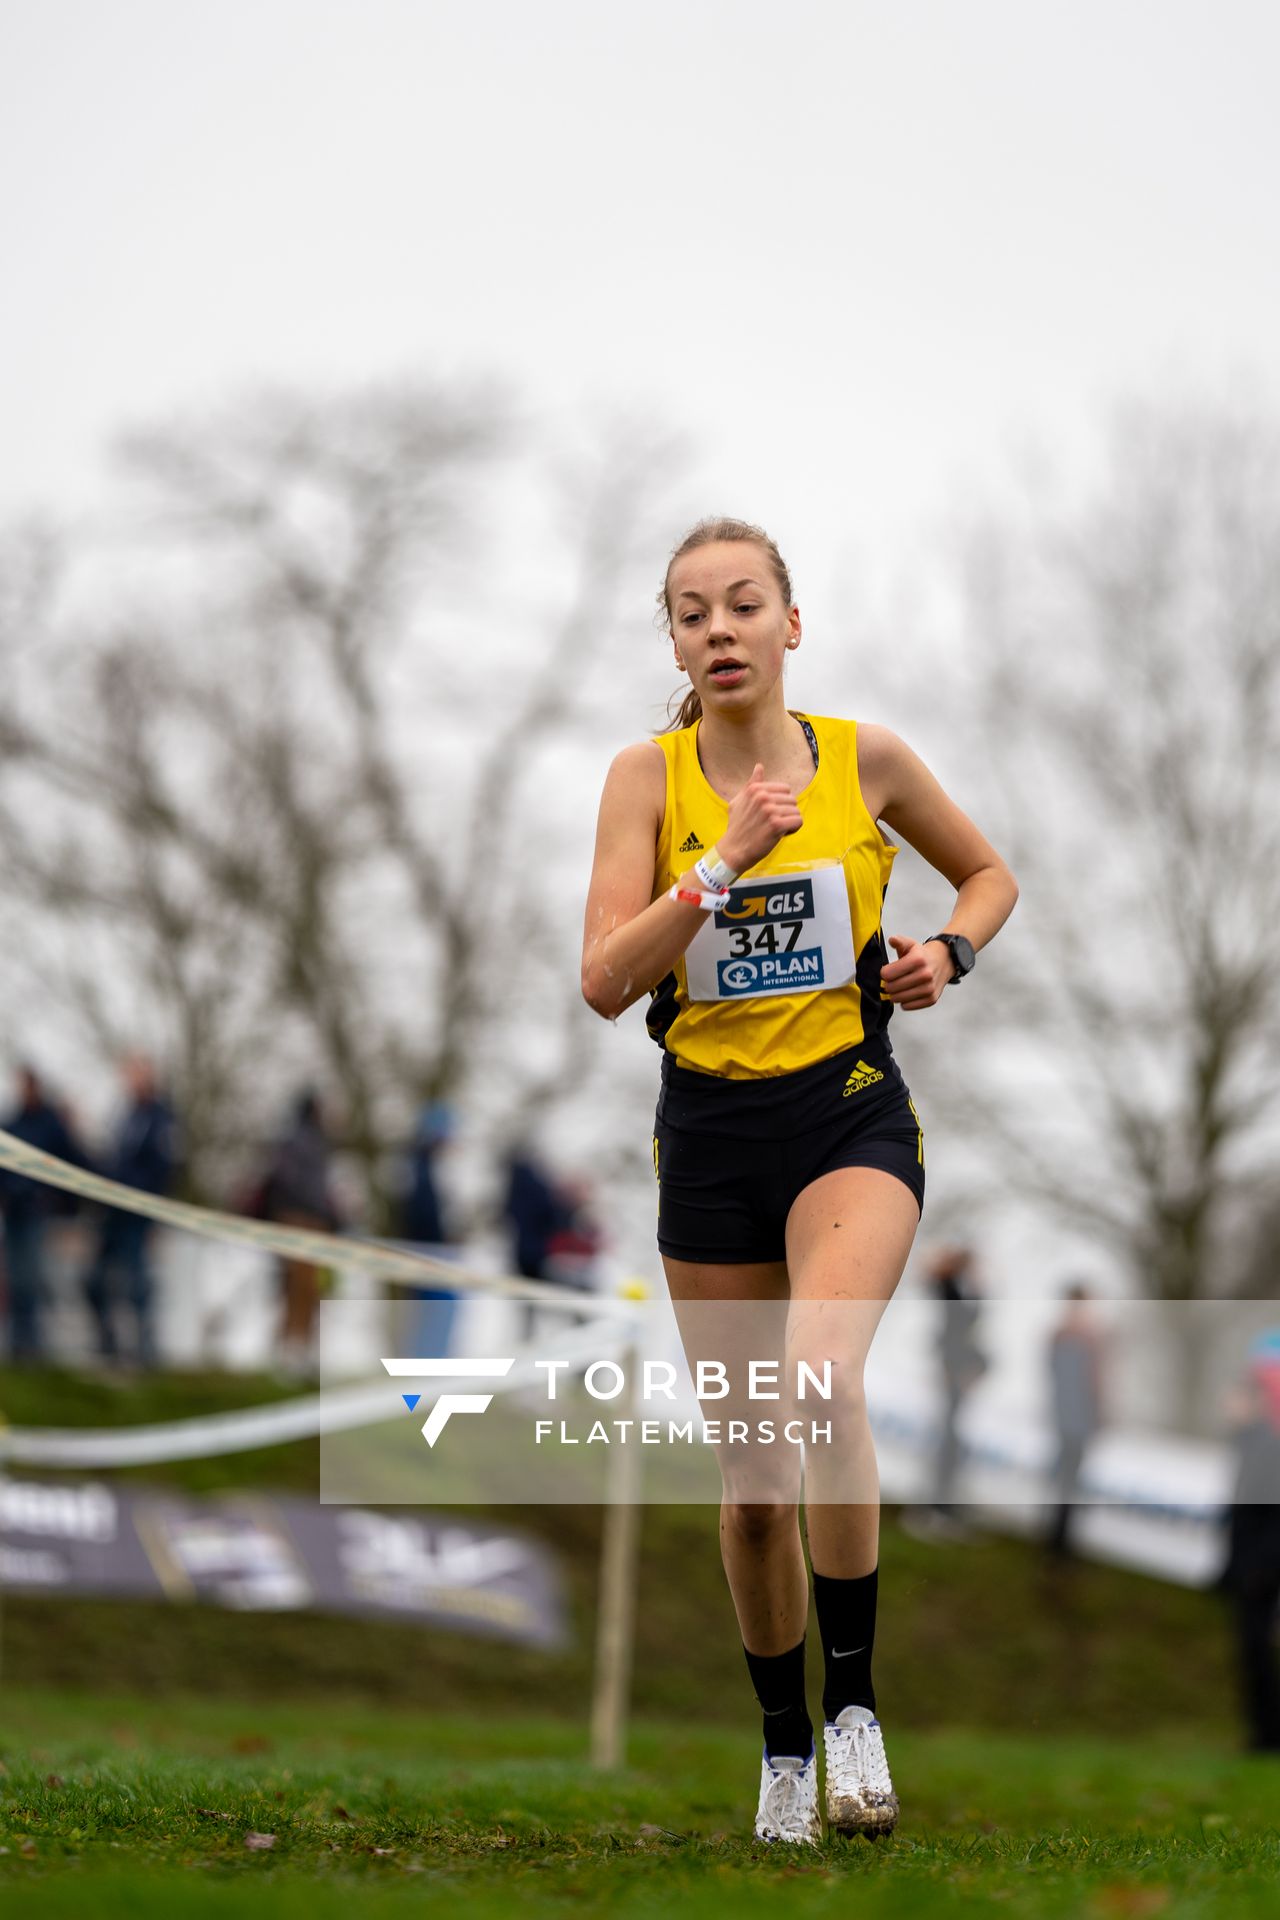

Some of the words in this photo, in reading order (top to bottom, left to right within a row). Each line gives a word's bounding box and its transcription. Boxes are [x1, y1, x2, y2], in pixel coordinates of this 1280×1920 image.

[679, 843, 704, 852] adidas
[767, 891, 805, 915] GLS
[729, 921, 803, 959] 347
[761, 955, 819, 977] PLAN
[763, 974, 820, 986] INTERNATIONAL
[842, 1070, 884, 1097] adidas
